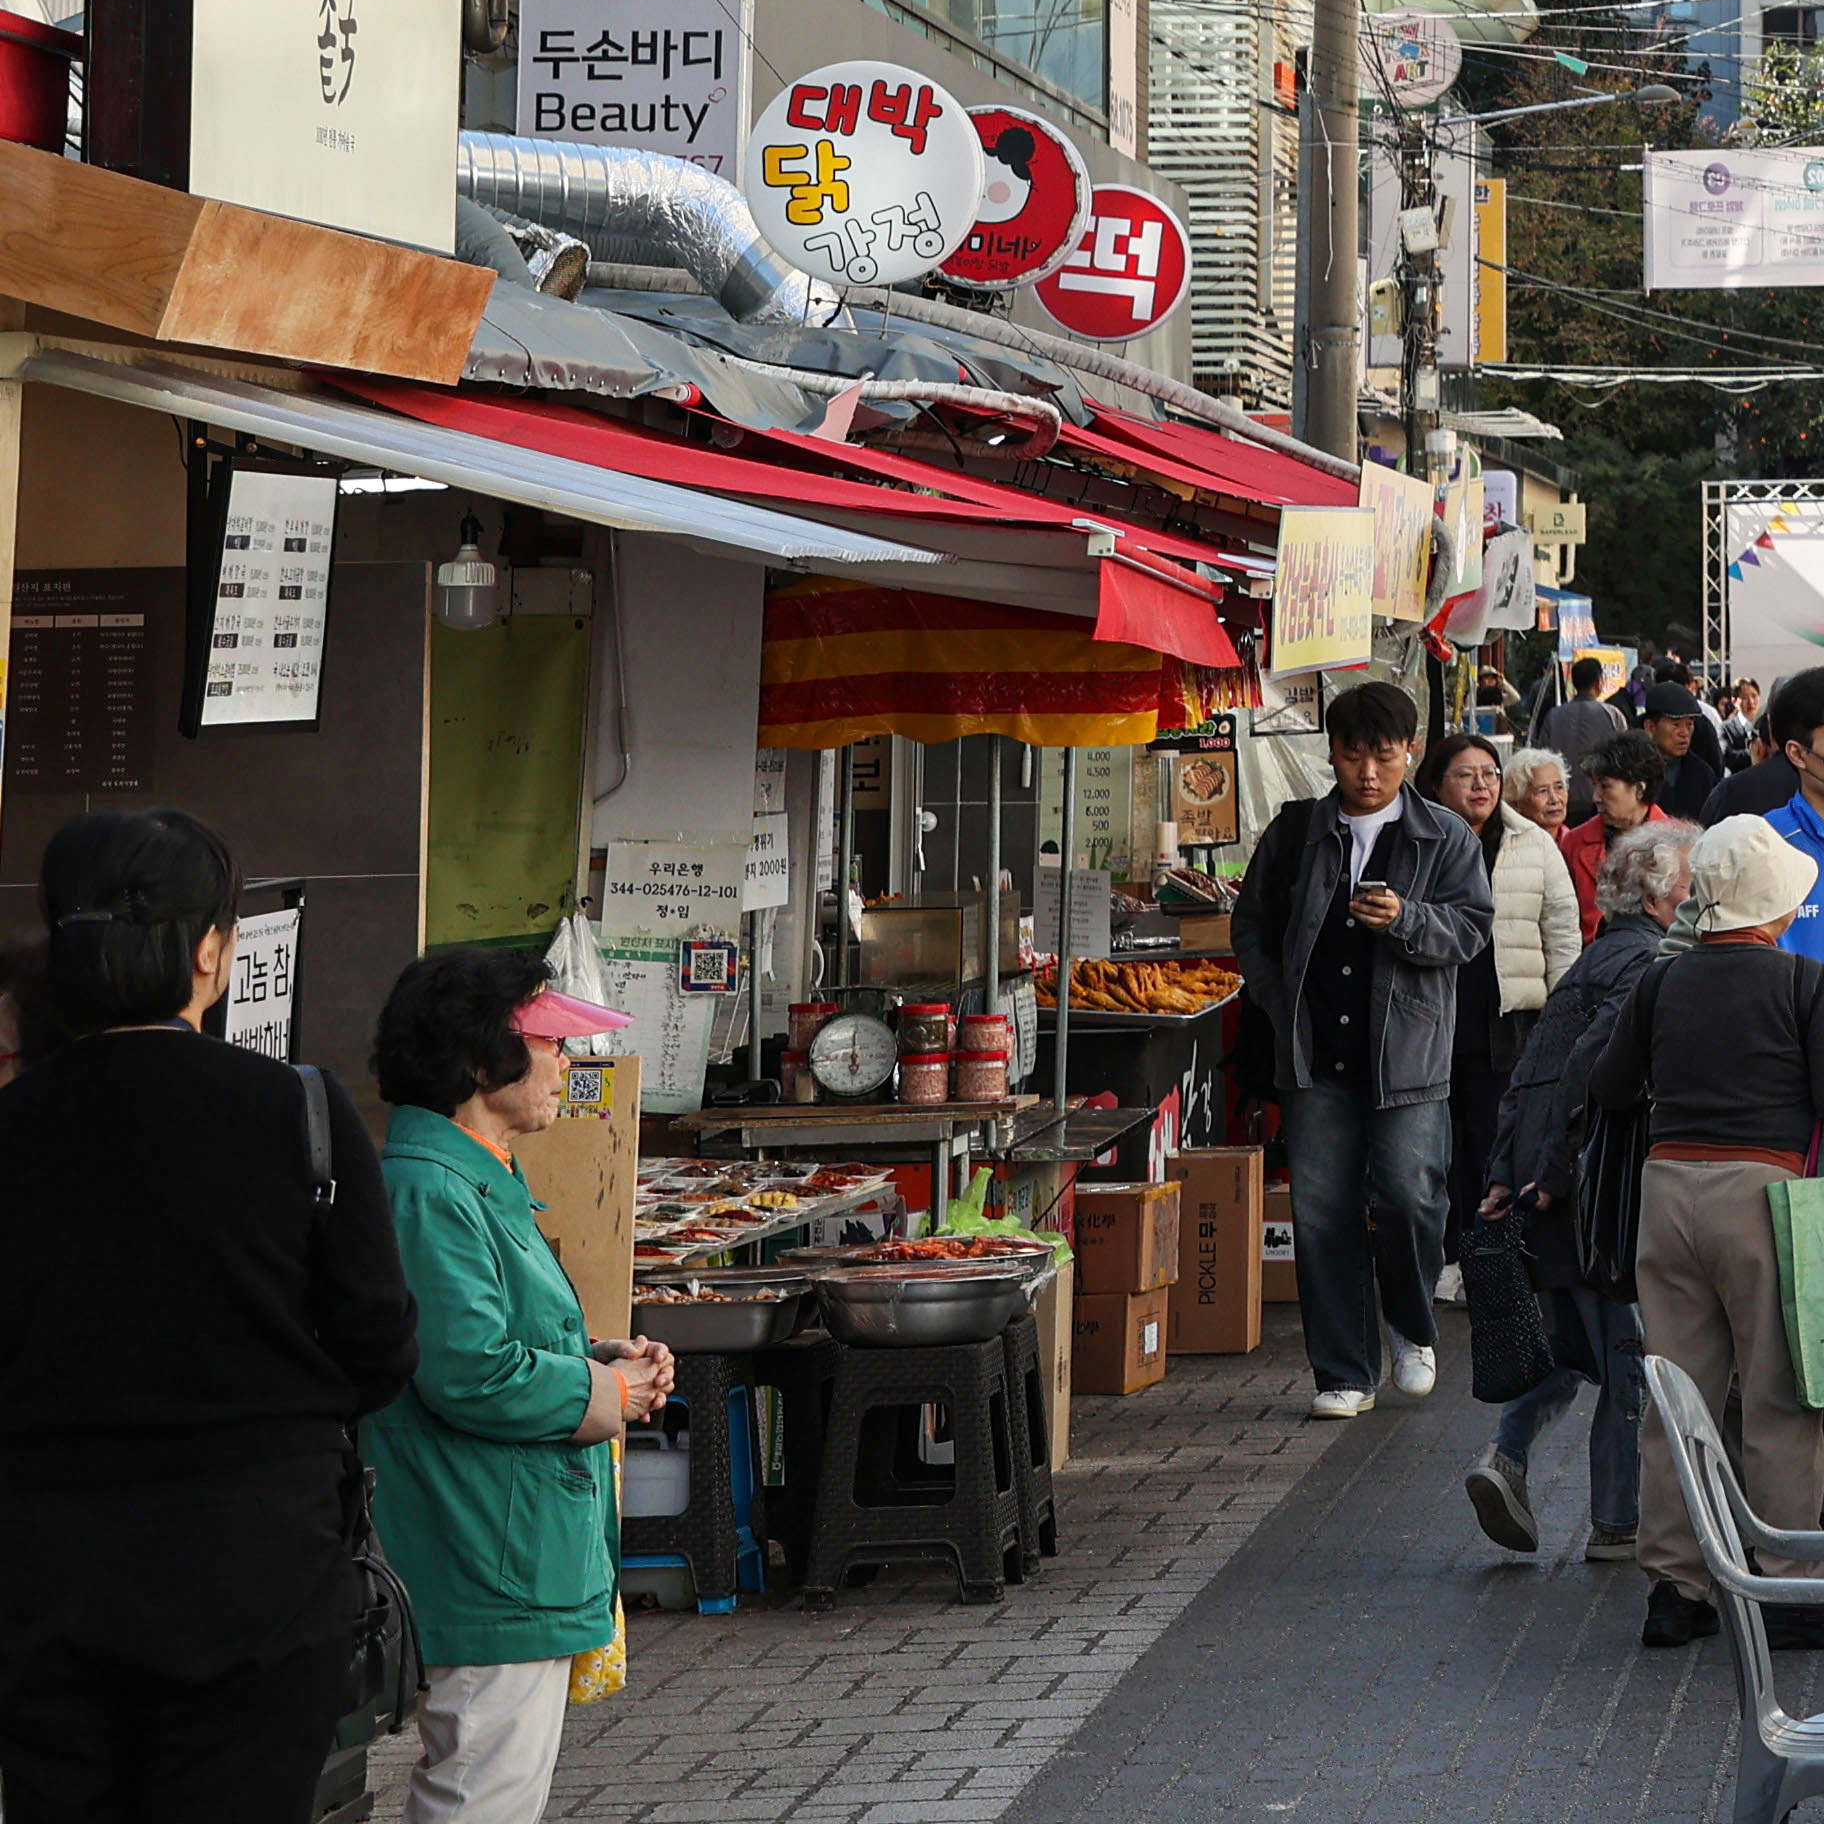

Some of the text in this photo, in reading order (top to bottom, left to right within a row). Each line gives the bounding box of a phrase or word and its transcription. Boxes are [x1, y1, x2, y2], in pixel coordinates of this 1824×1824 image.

[531, 28, 725, 83] 두손바디
[1393, 59, 1429, 83] ART
[534, 90, 711, 145] Beauty
[786, 78, 943, 156] 대박
[762, 139, 852, 226] 닭
[804, 190, 946, 285] 강정
[1283, 686, 1318, 705] 김밥
[1092, 820, 1110, 831] 500
[1180, 808, 1213, 826] 족발
[649, 862, 704, 877] 우리은행
[759, 857, 787, 877] 2000원
[610, 882, 738, 898] 344-025476-12-101
[233, 943, 293, 1004] 고놈 참,
[1199, 1240, 1218, 1305] PICKLE
